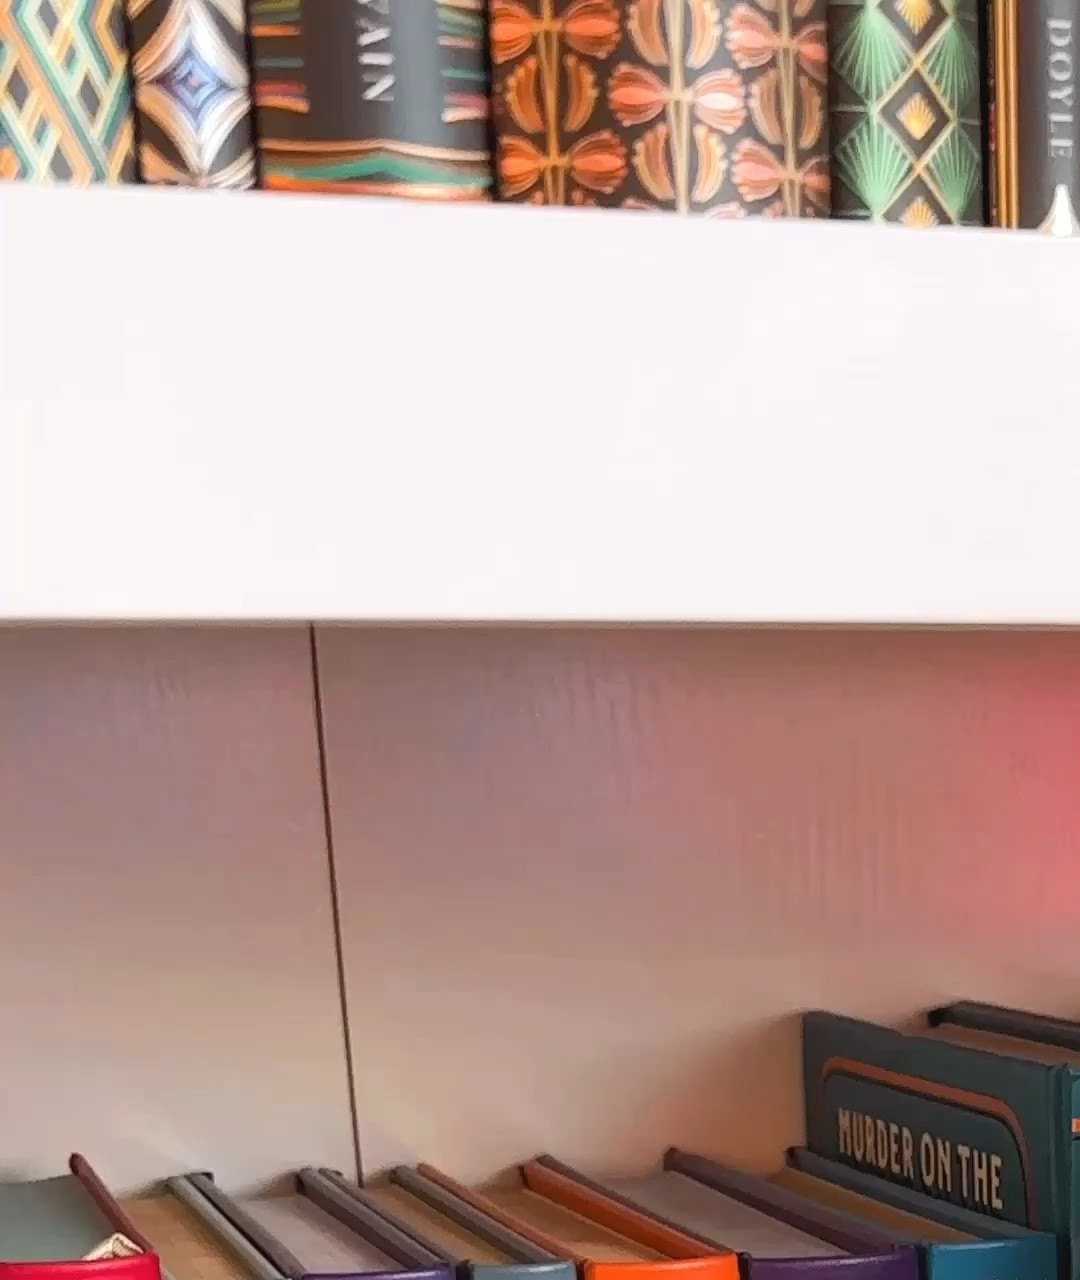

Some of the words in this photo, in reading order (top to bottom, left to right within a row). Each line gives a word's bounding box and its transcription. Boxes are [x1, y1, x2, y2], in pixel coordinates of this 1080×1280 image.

[355, 0, 396, 102] AIN
[1046, 18, 1075, 160] DOYLE
[837, 1106, 915, 1186] MURDER
[920, 1131, 952, 1193] ON
[957, 1143, 1005, 1212] THE
